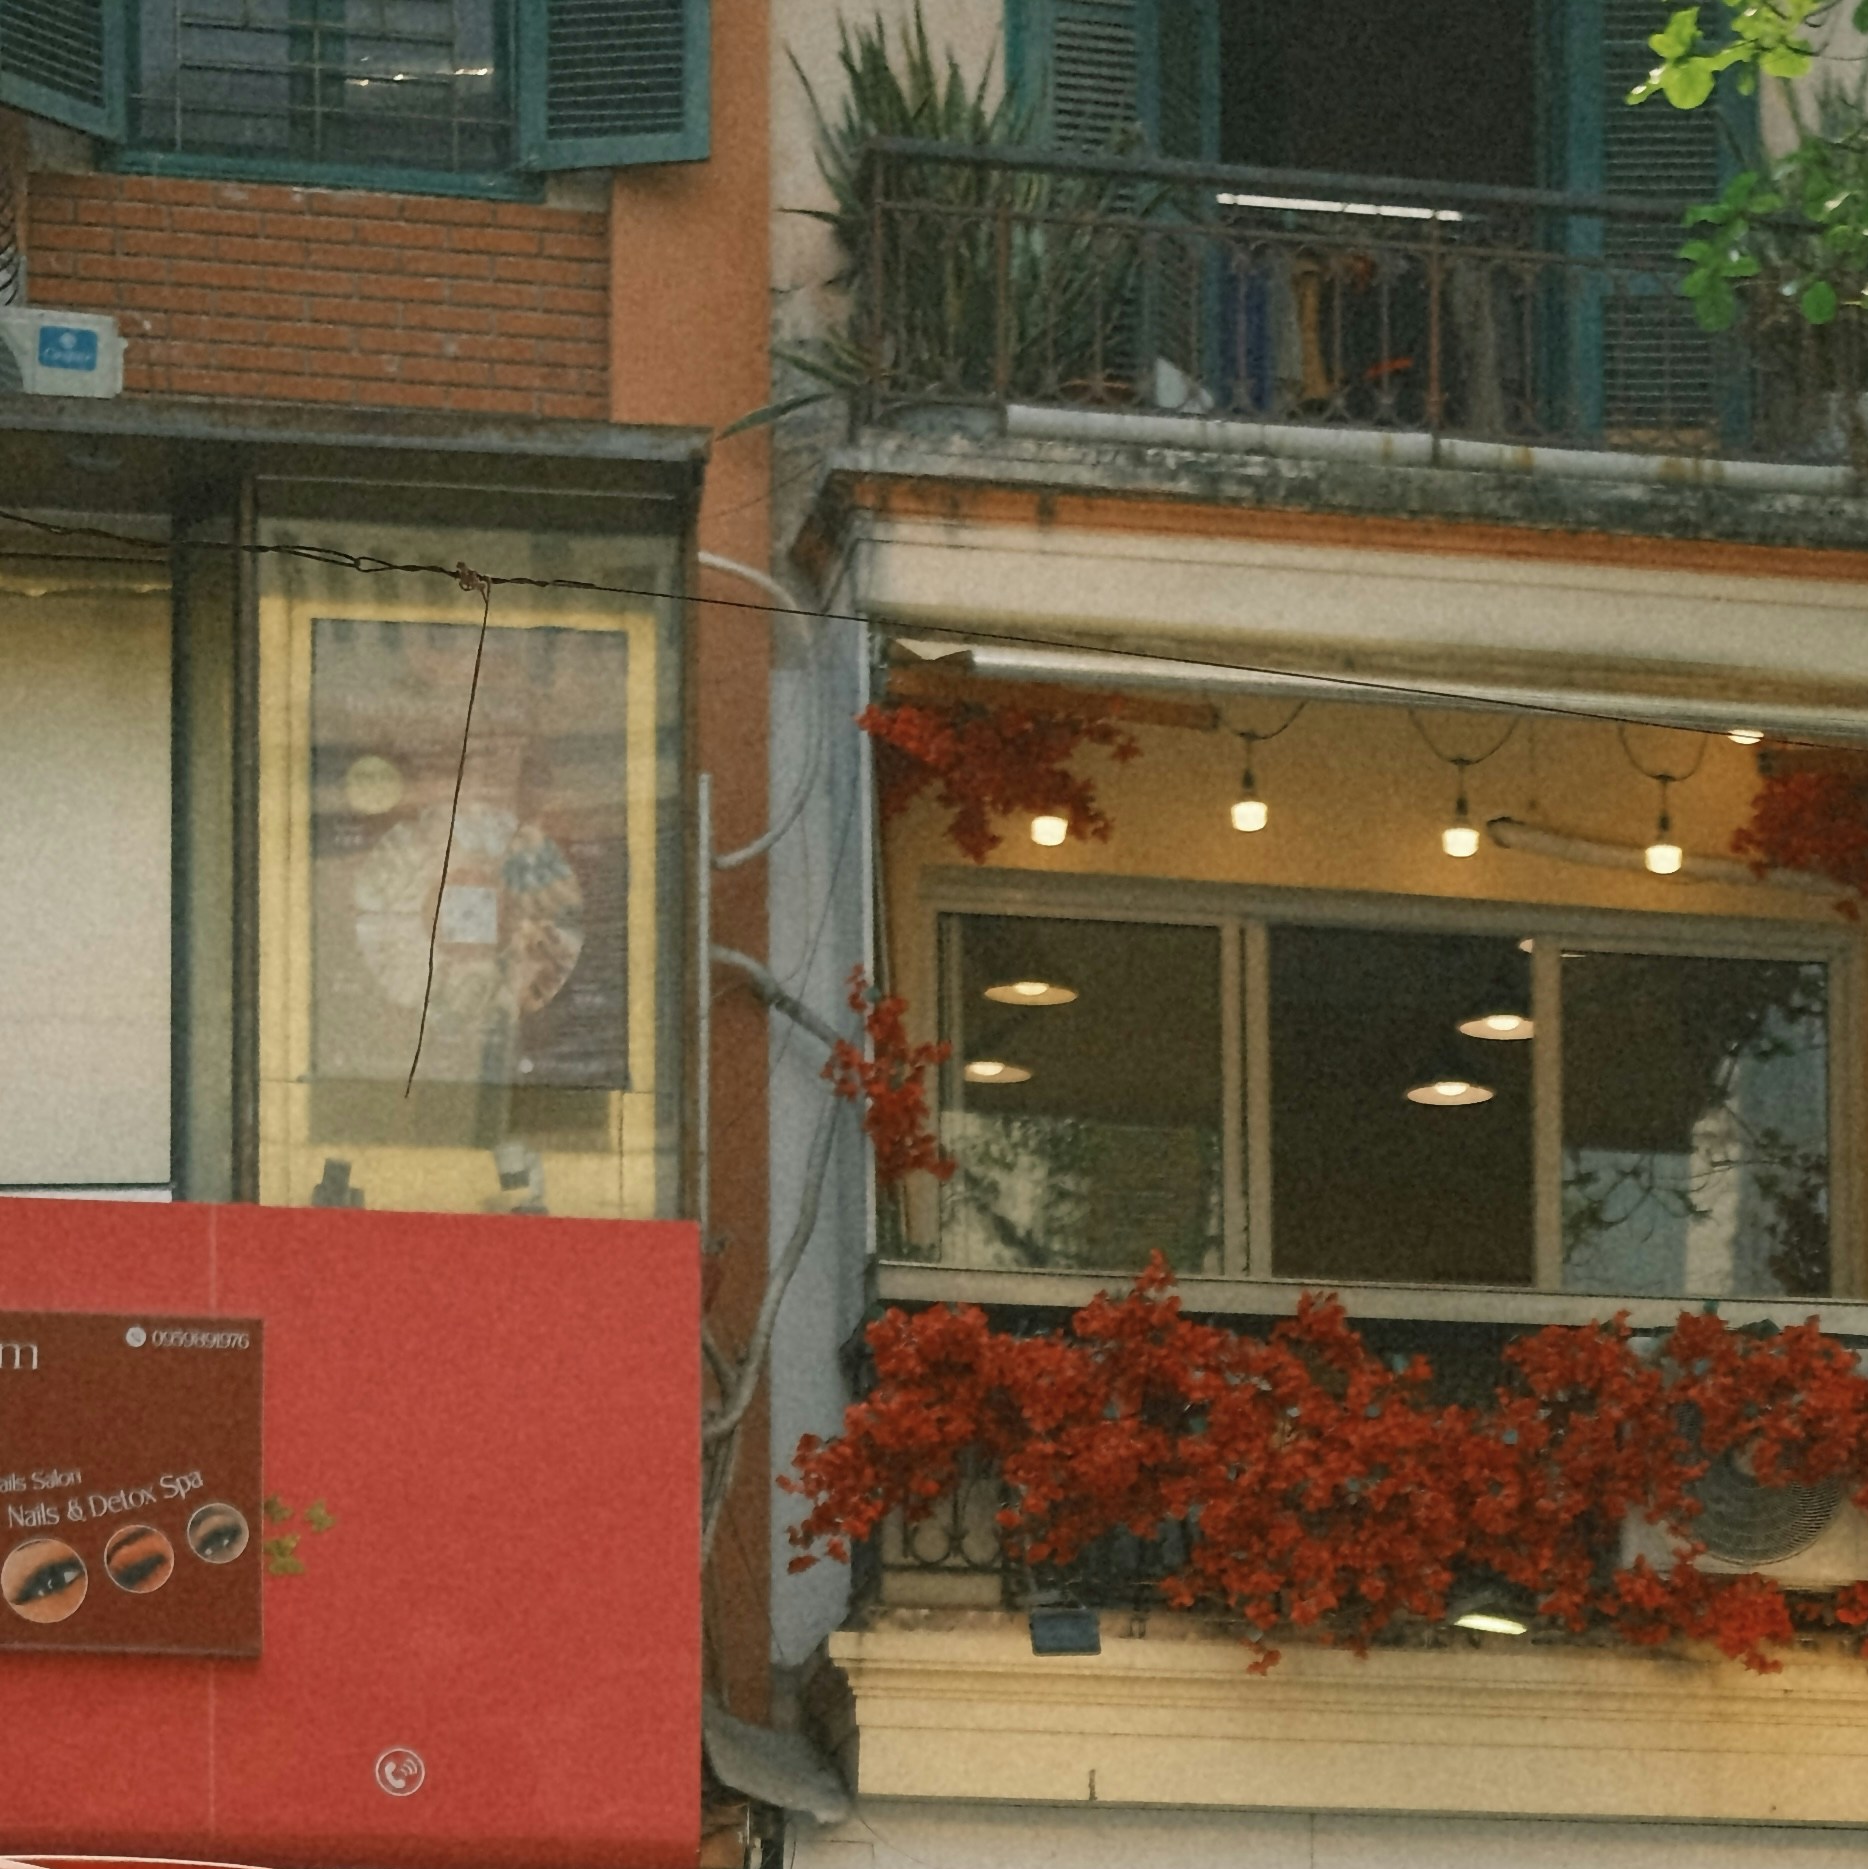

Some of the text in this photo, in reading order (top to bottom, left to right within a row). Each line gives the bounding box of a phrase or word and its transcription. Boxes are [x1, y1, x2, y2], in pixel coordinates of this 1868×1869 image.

[7, 1469, 204, 1528] Nails & Detox Spa
[31, 1468, 83, 1491] Salon
